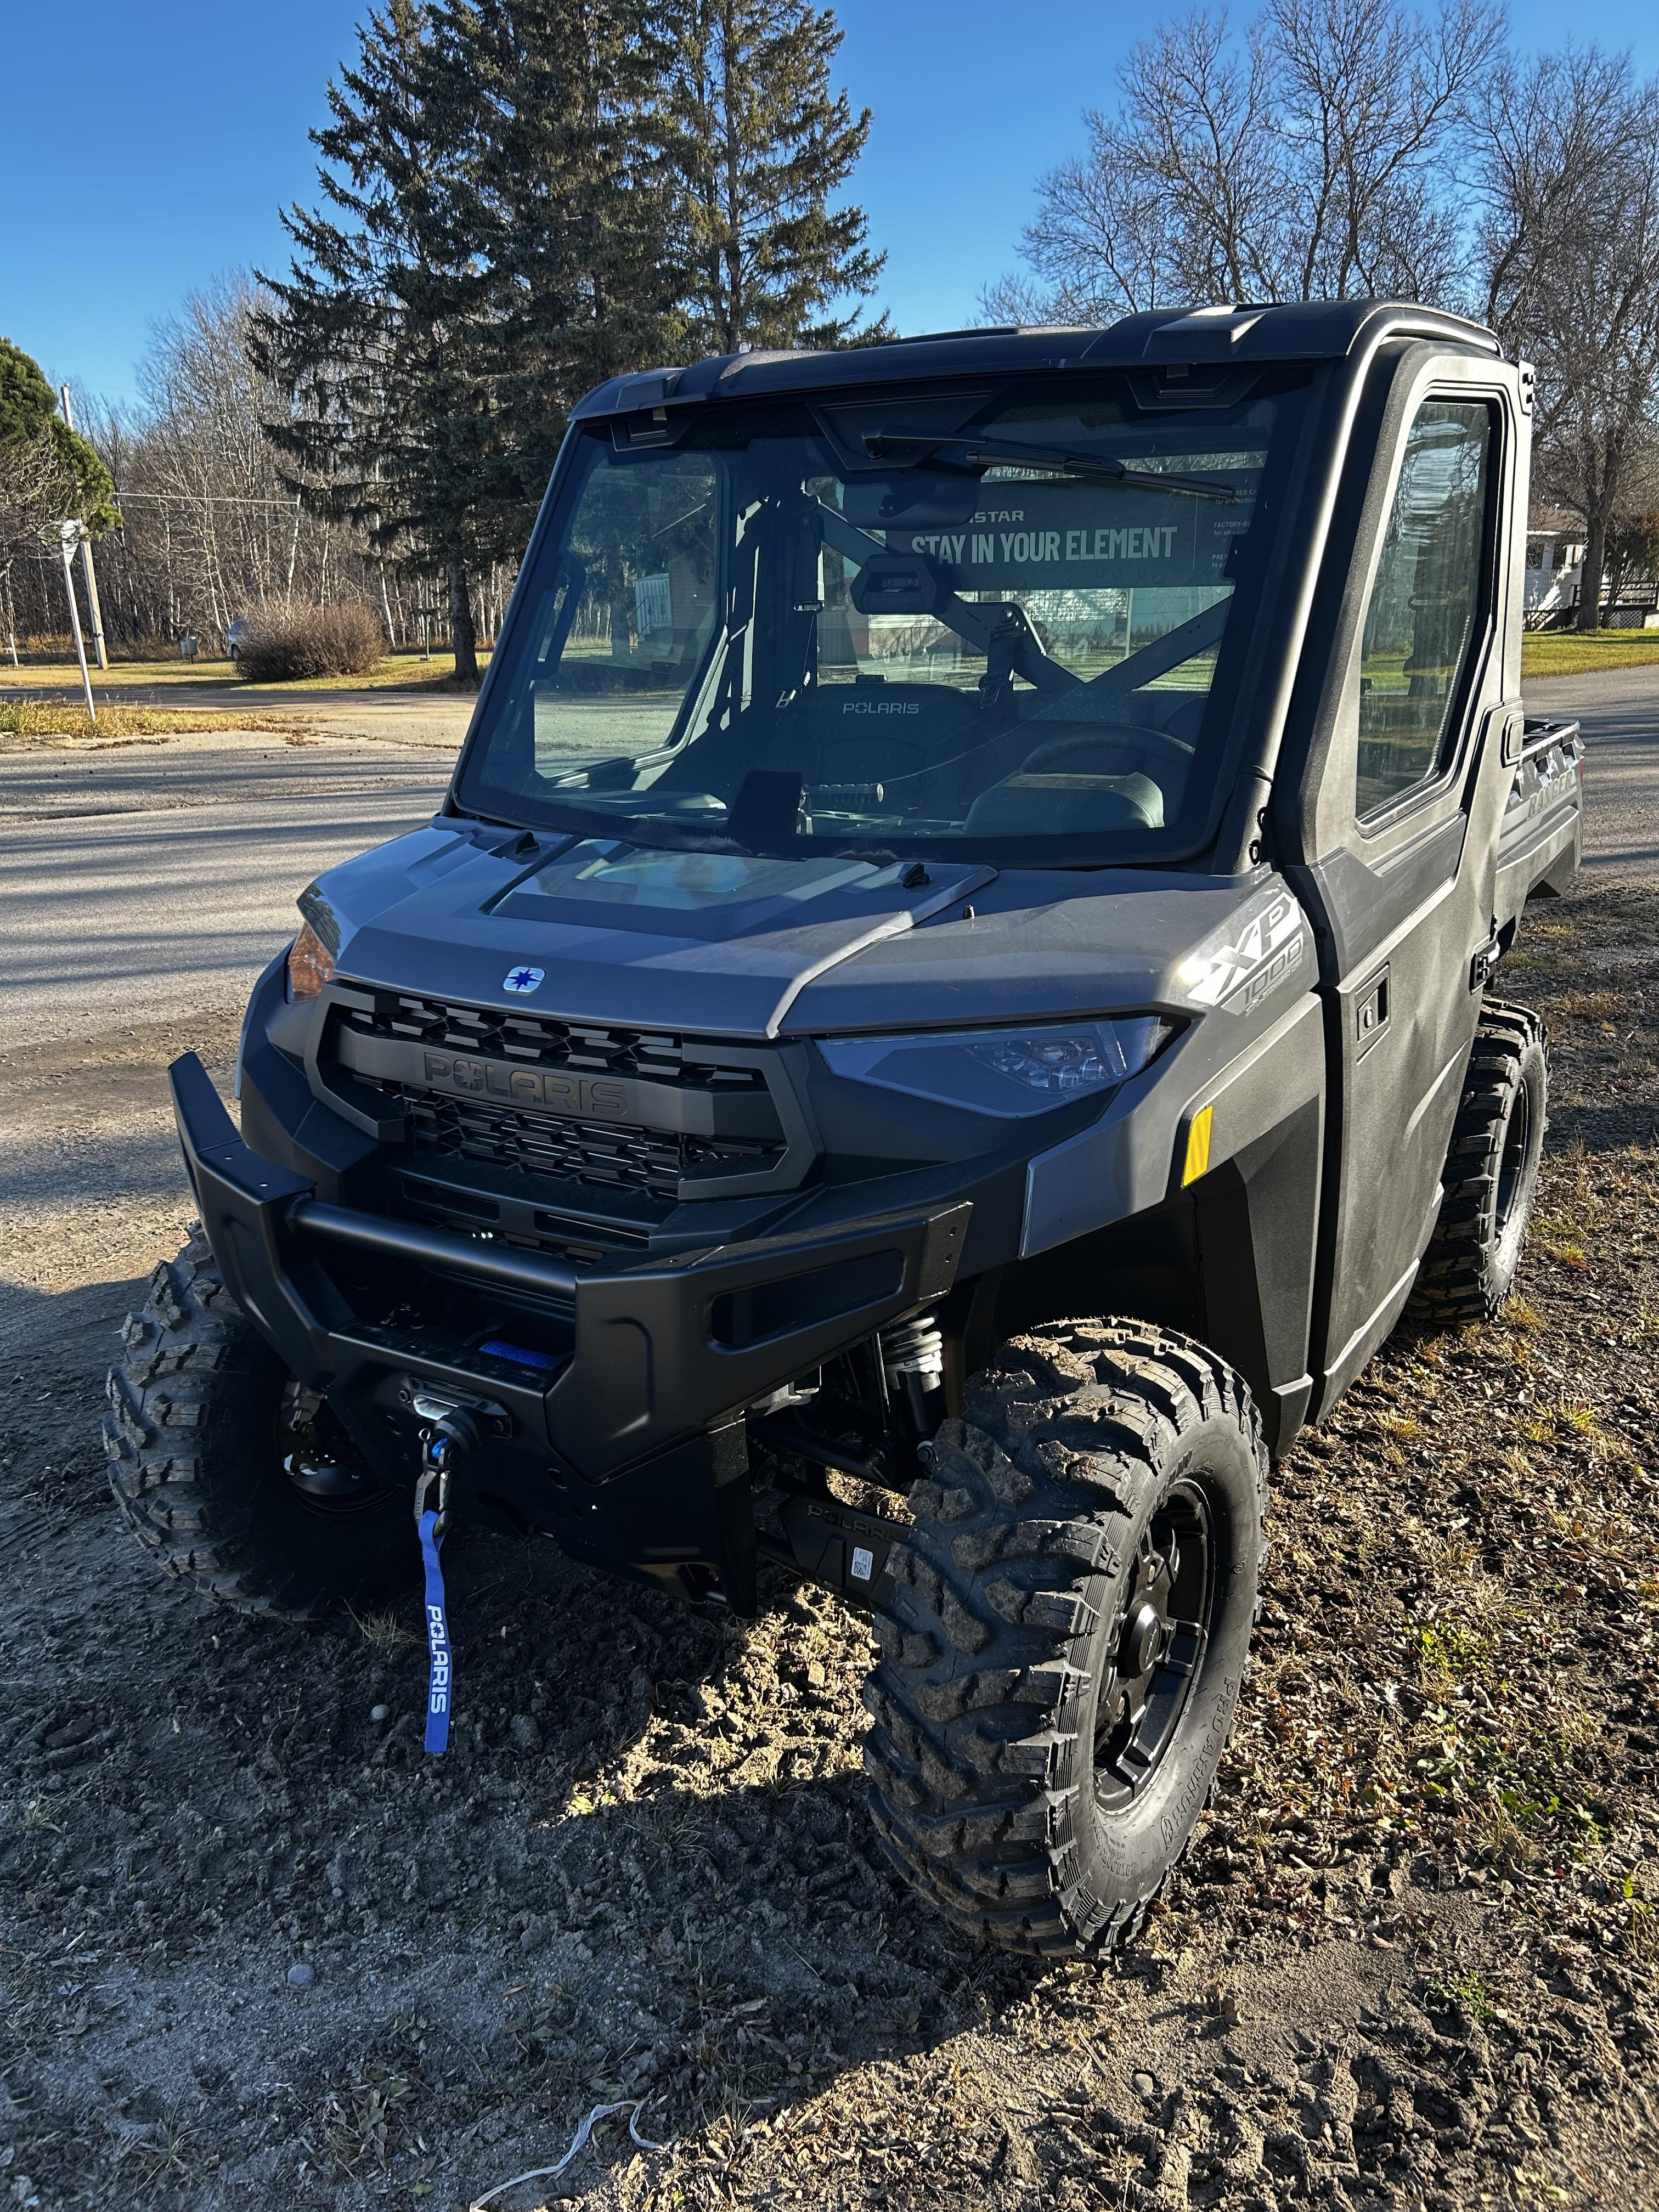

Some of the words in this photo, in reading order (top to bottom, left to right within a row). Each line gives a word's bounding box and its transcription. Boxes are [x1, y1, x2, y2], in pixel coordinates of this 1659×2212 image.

[912, 534, 966, 564] STAY
[972, 533, 994, 563] IN
[1000, 531, 1060, 562] YOUR
[1066, 527, 1178, 561] ELEMENT
[843, 703, 920, 715] POLARIS
[1527, 769, 1575, 821] RANGER
[1187, 891, 1302, 1006] XP
[1244, 937, 1302, 1006] 1000
[424, 1051, 629, 1118] POLARIS
[427, 1604, 449, 1714] POLARIS
